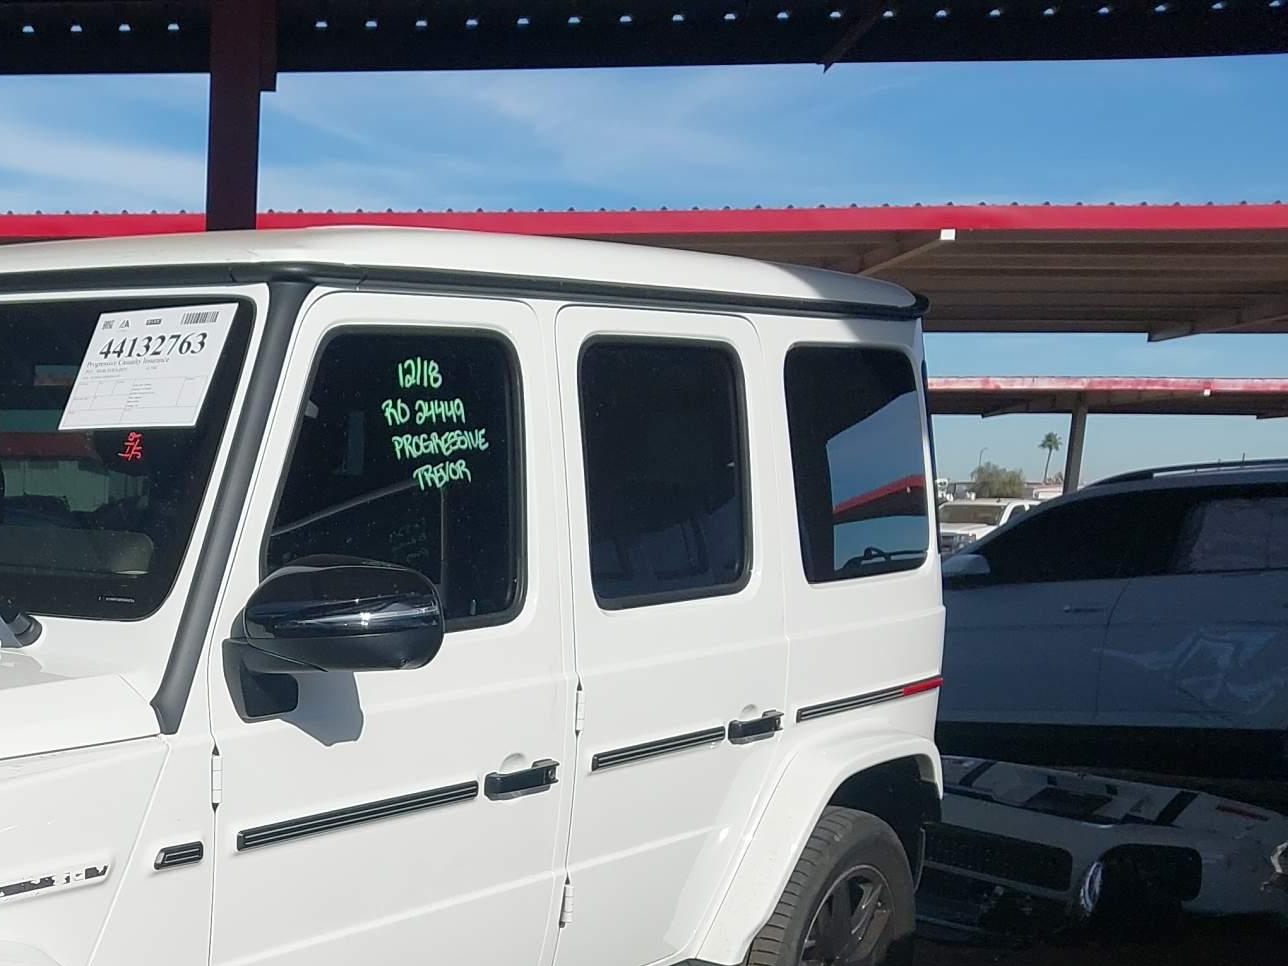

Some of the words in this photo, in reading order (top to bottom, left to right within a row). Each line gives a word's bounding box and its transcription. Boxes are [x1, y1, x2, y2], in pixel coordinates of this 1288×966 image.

[99, 332, 208, 359] 44132763
[414, 398, 466, 425] 24449
[391, 428, 489, 460] PROGRESSIVE
[413, 459, 472, 491] TREVOR
